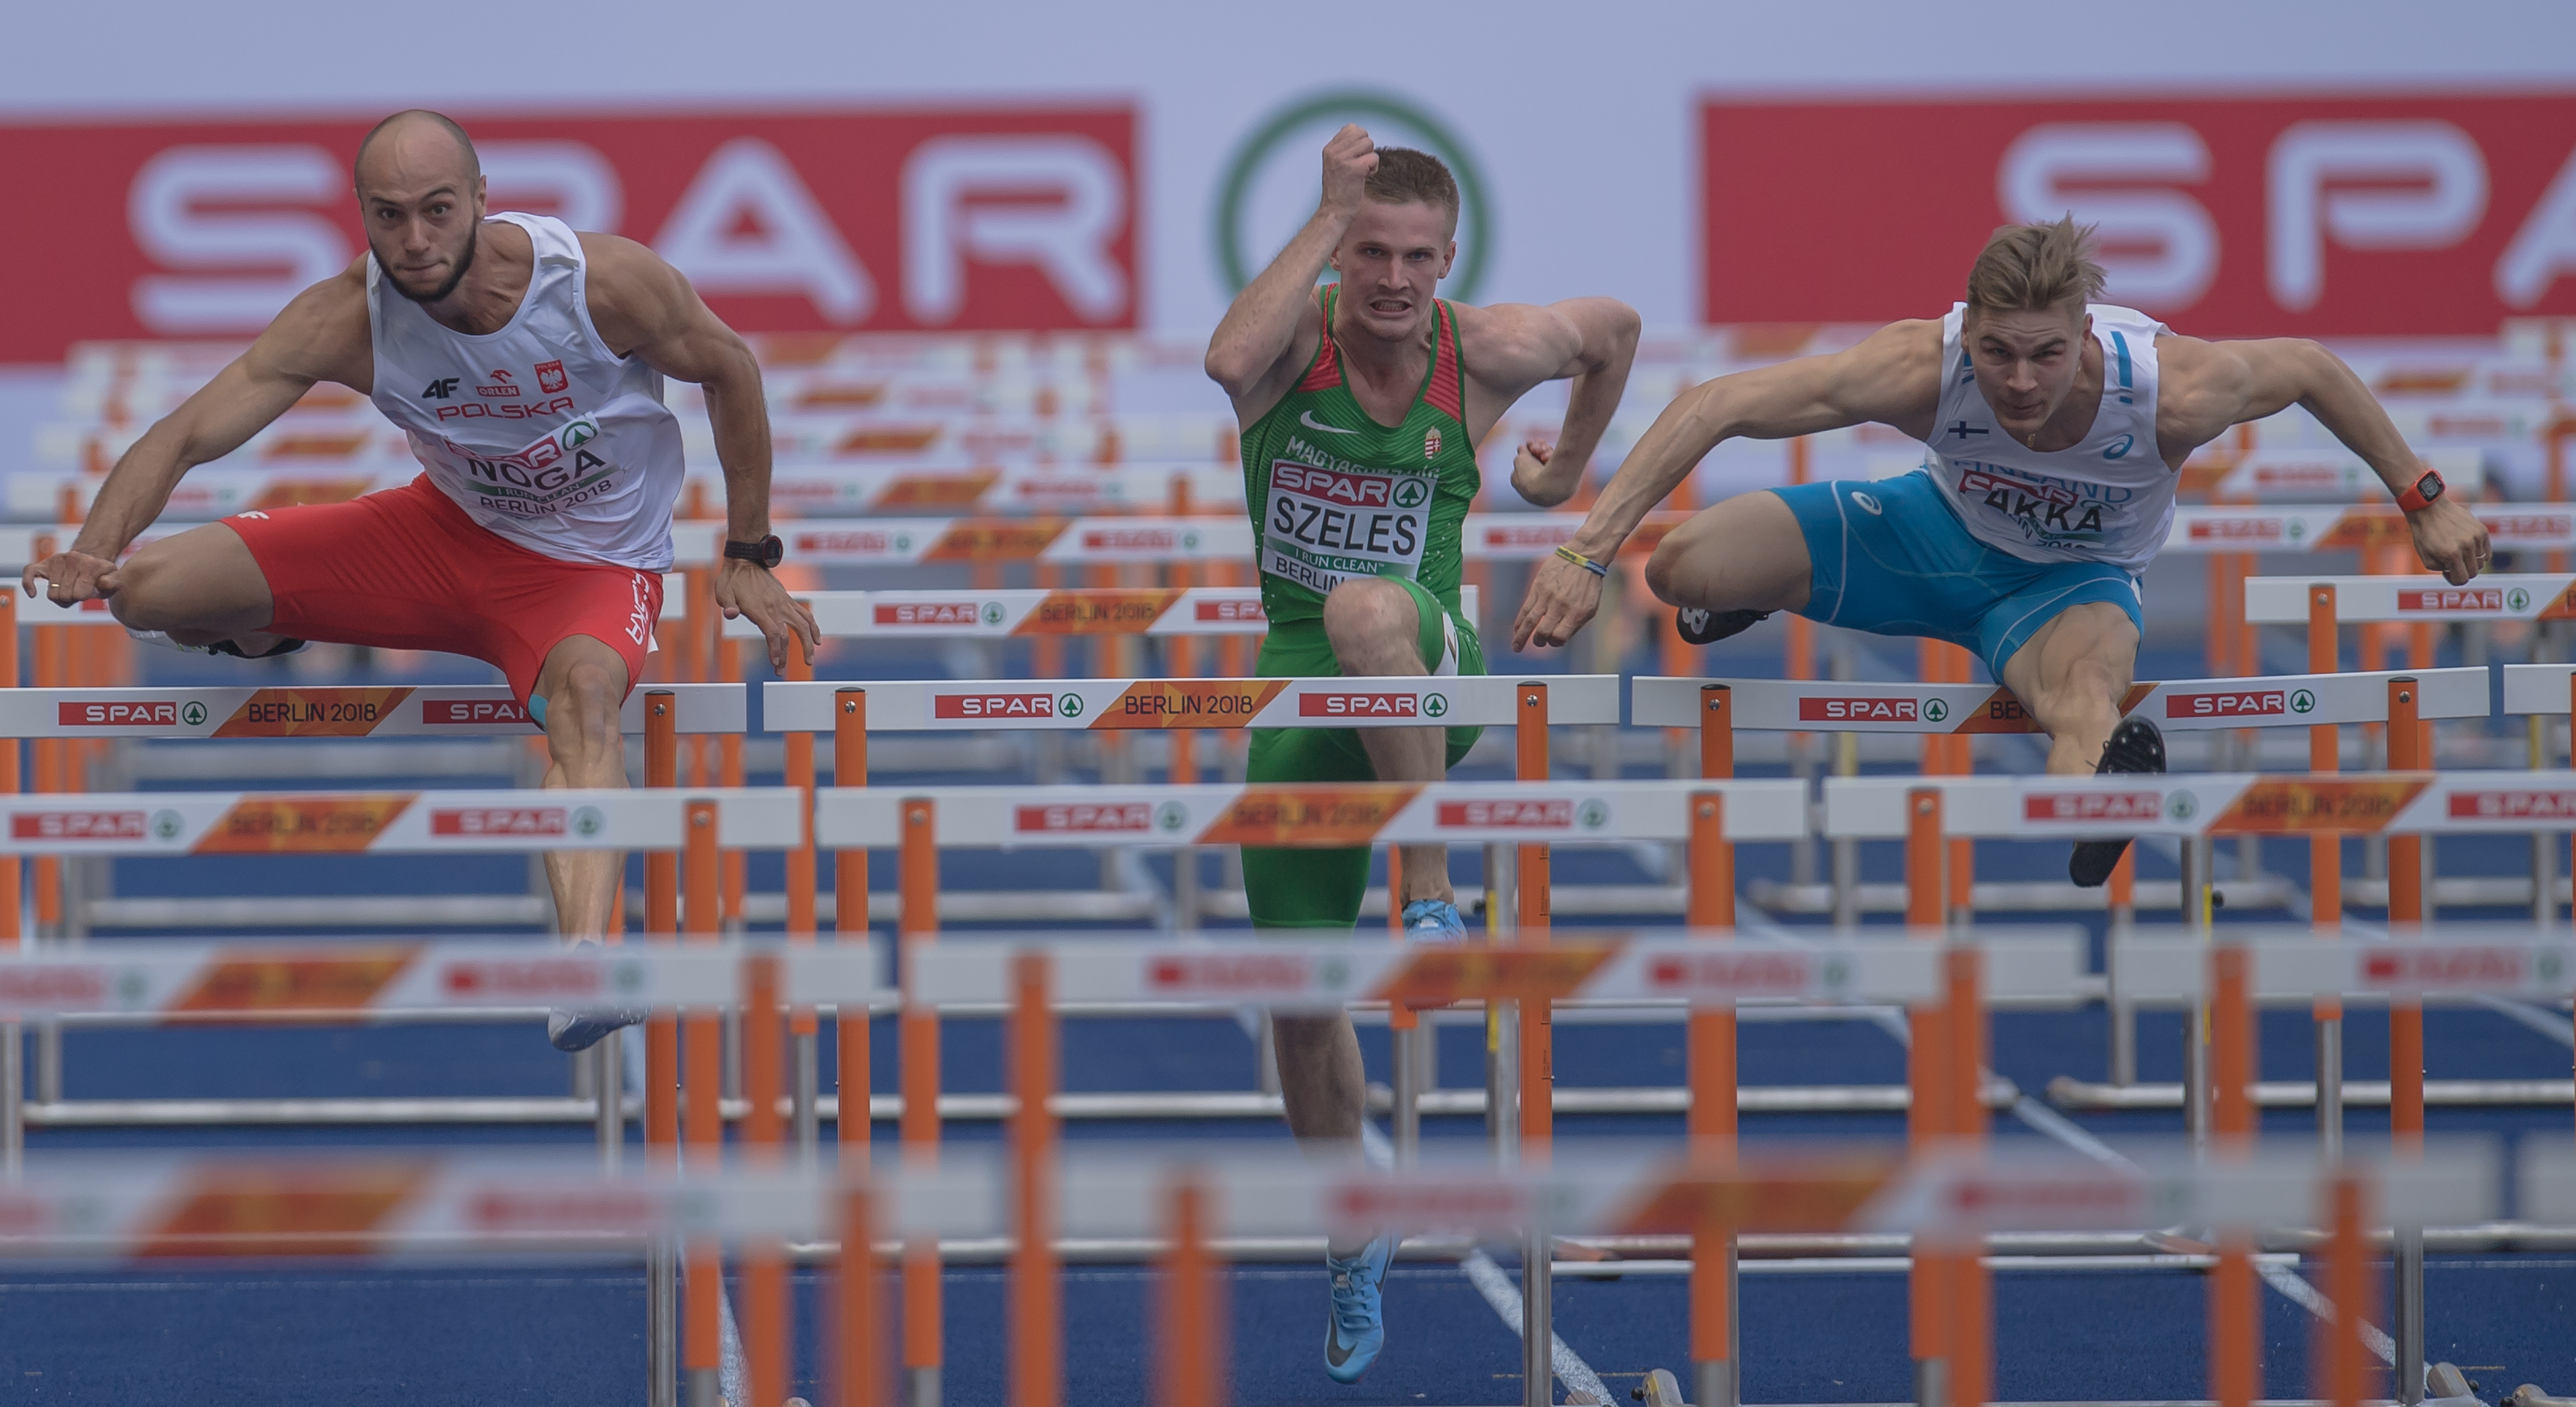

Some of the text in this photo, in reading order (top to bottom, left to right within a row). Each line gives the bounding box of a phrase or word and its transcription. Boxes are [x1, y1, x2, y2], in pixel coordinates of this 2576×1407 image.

[479, 386, 517, 396] ORLEN
[436, 396, 574, 422] POLSKA
[468, 448, 606, 491] NOGA
[1276, 465, 1388, 504] SPAR
[480, 479, 612, 514] BERLIN 2018
[504, 489, 535, 501] RUN
[1983, 487, 2103, 533] AKKA
[1274, 496, 1418, 556] SZELES
[1302, 552, 1329, 568] RUN
[2421, 590, 2502, 610] SPAR
[896, 605, 977, 624] SPAR
[249, 702, 377, 723] BERLIN 2018
[962, 697, 1051, 715] SPAR
[1124, 695, 1253, 715] BERLIN 2018
[1325, 697, 1416, 714] SPAR
[1826, 701, 1916, 718] SPAR
[2194, 694, 2283, 713] SPAR
[85, 705, 175, 722] SPAR
